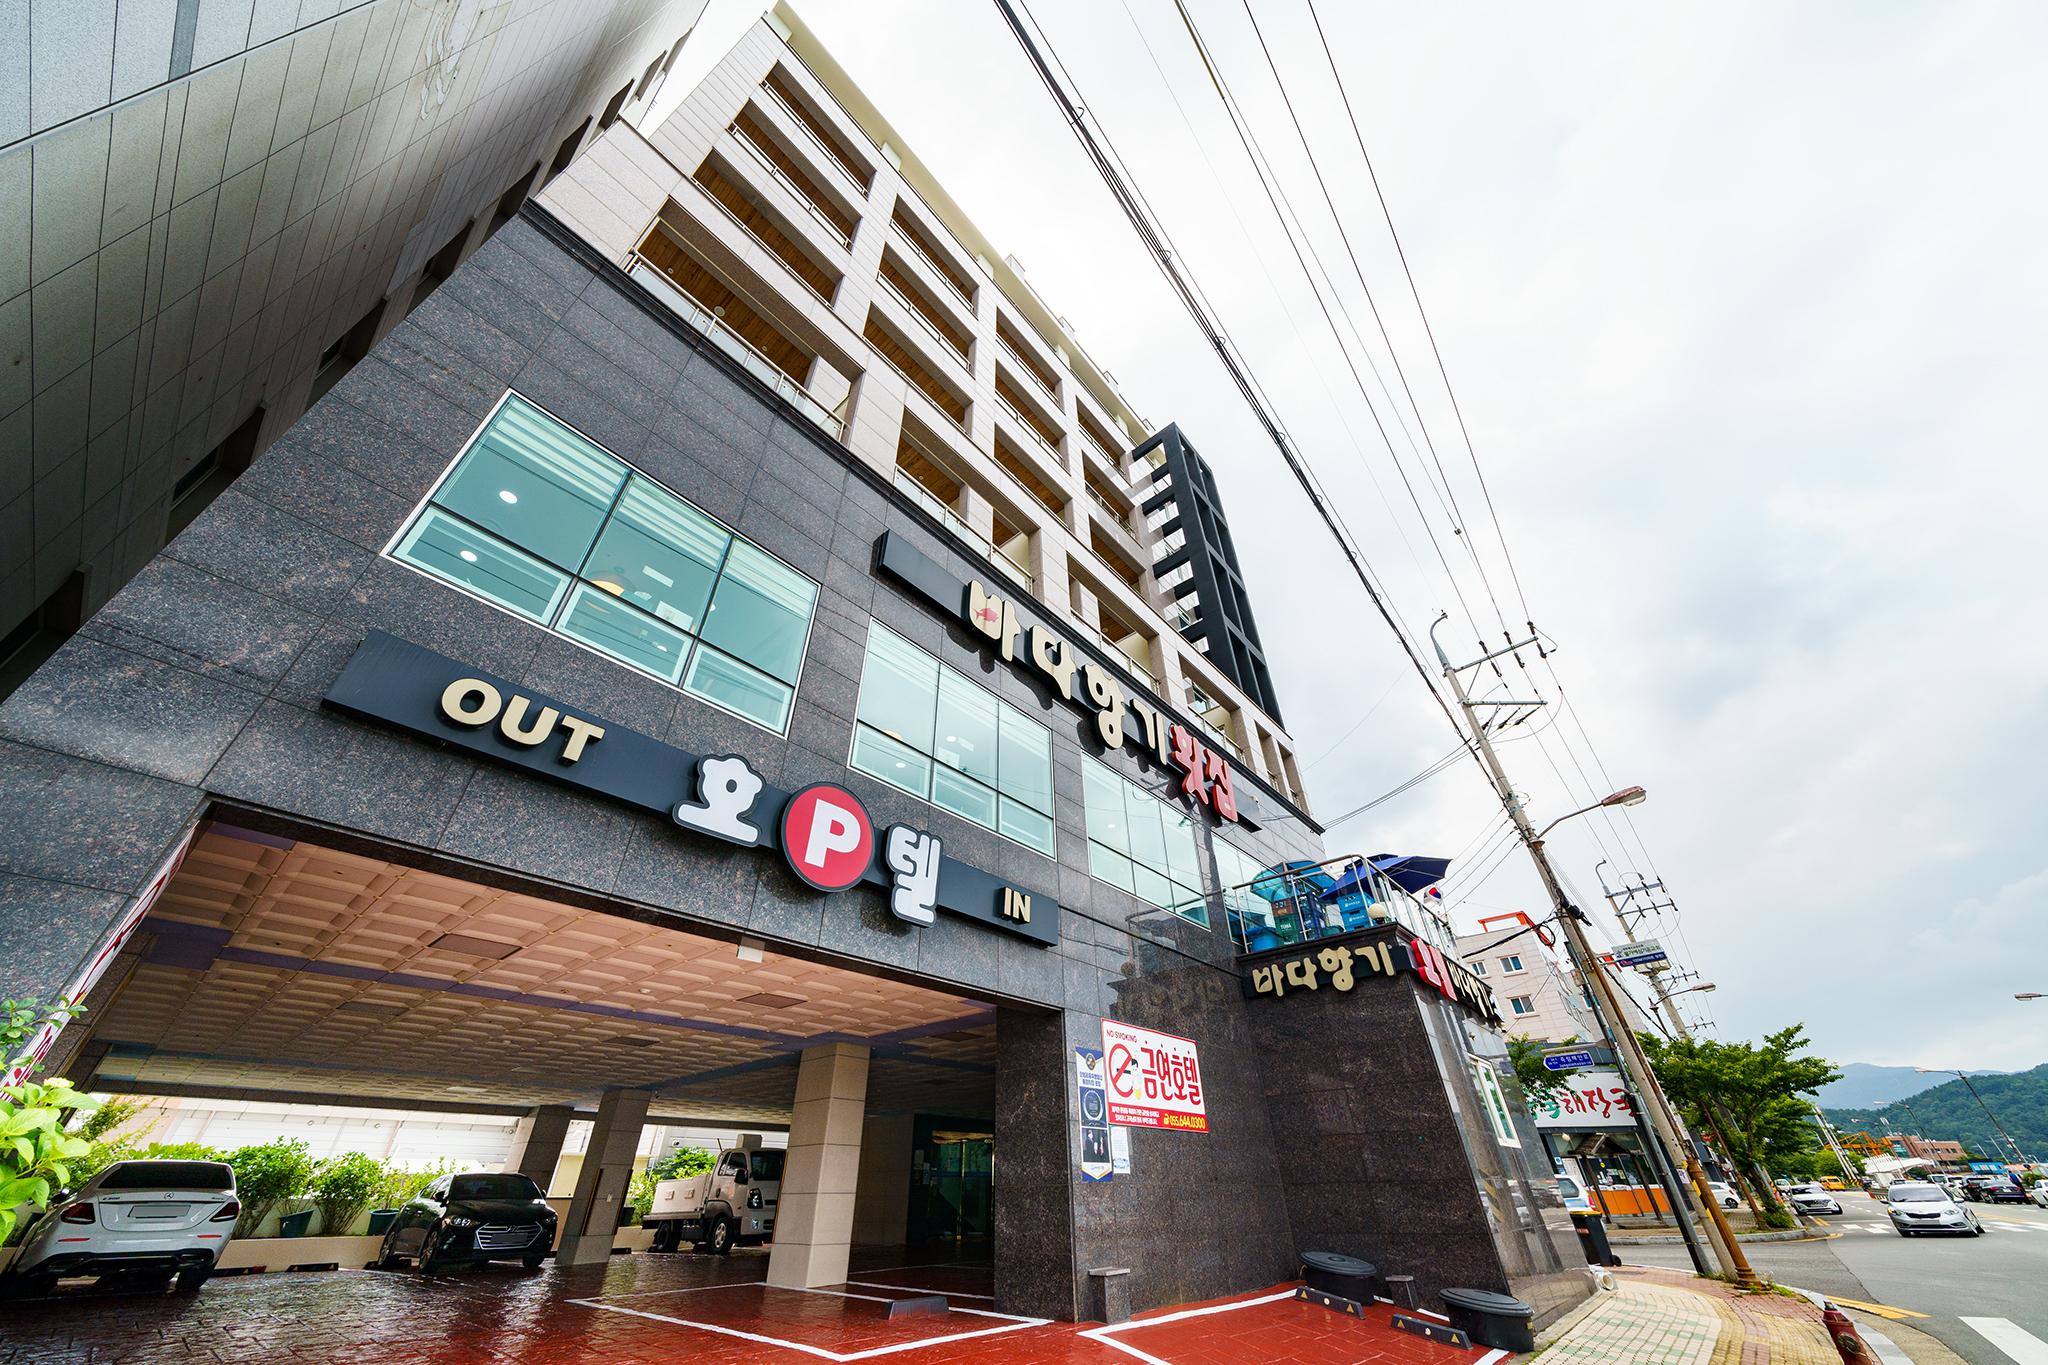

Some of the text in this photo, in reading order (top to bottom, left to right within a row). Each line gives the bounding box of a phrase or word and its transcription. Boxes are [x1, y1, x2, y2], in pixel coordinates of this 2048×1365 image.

[968, 580, 1167, 765] 바다향기
[441, 677, 605, 765] OUT
[1003, 886, 1031, 924] IN
[1252, 941, 1395, 997] 바다향기
[1106, 1029, 1138, 1043] NO SMOKING
[1140, 1047, 1201, 1105] 금연호텔
